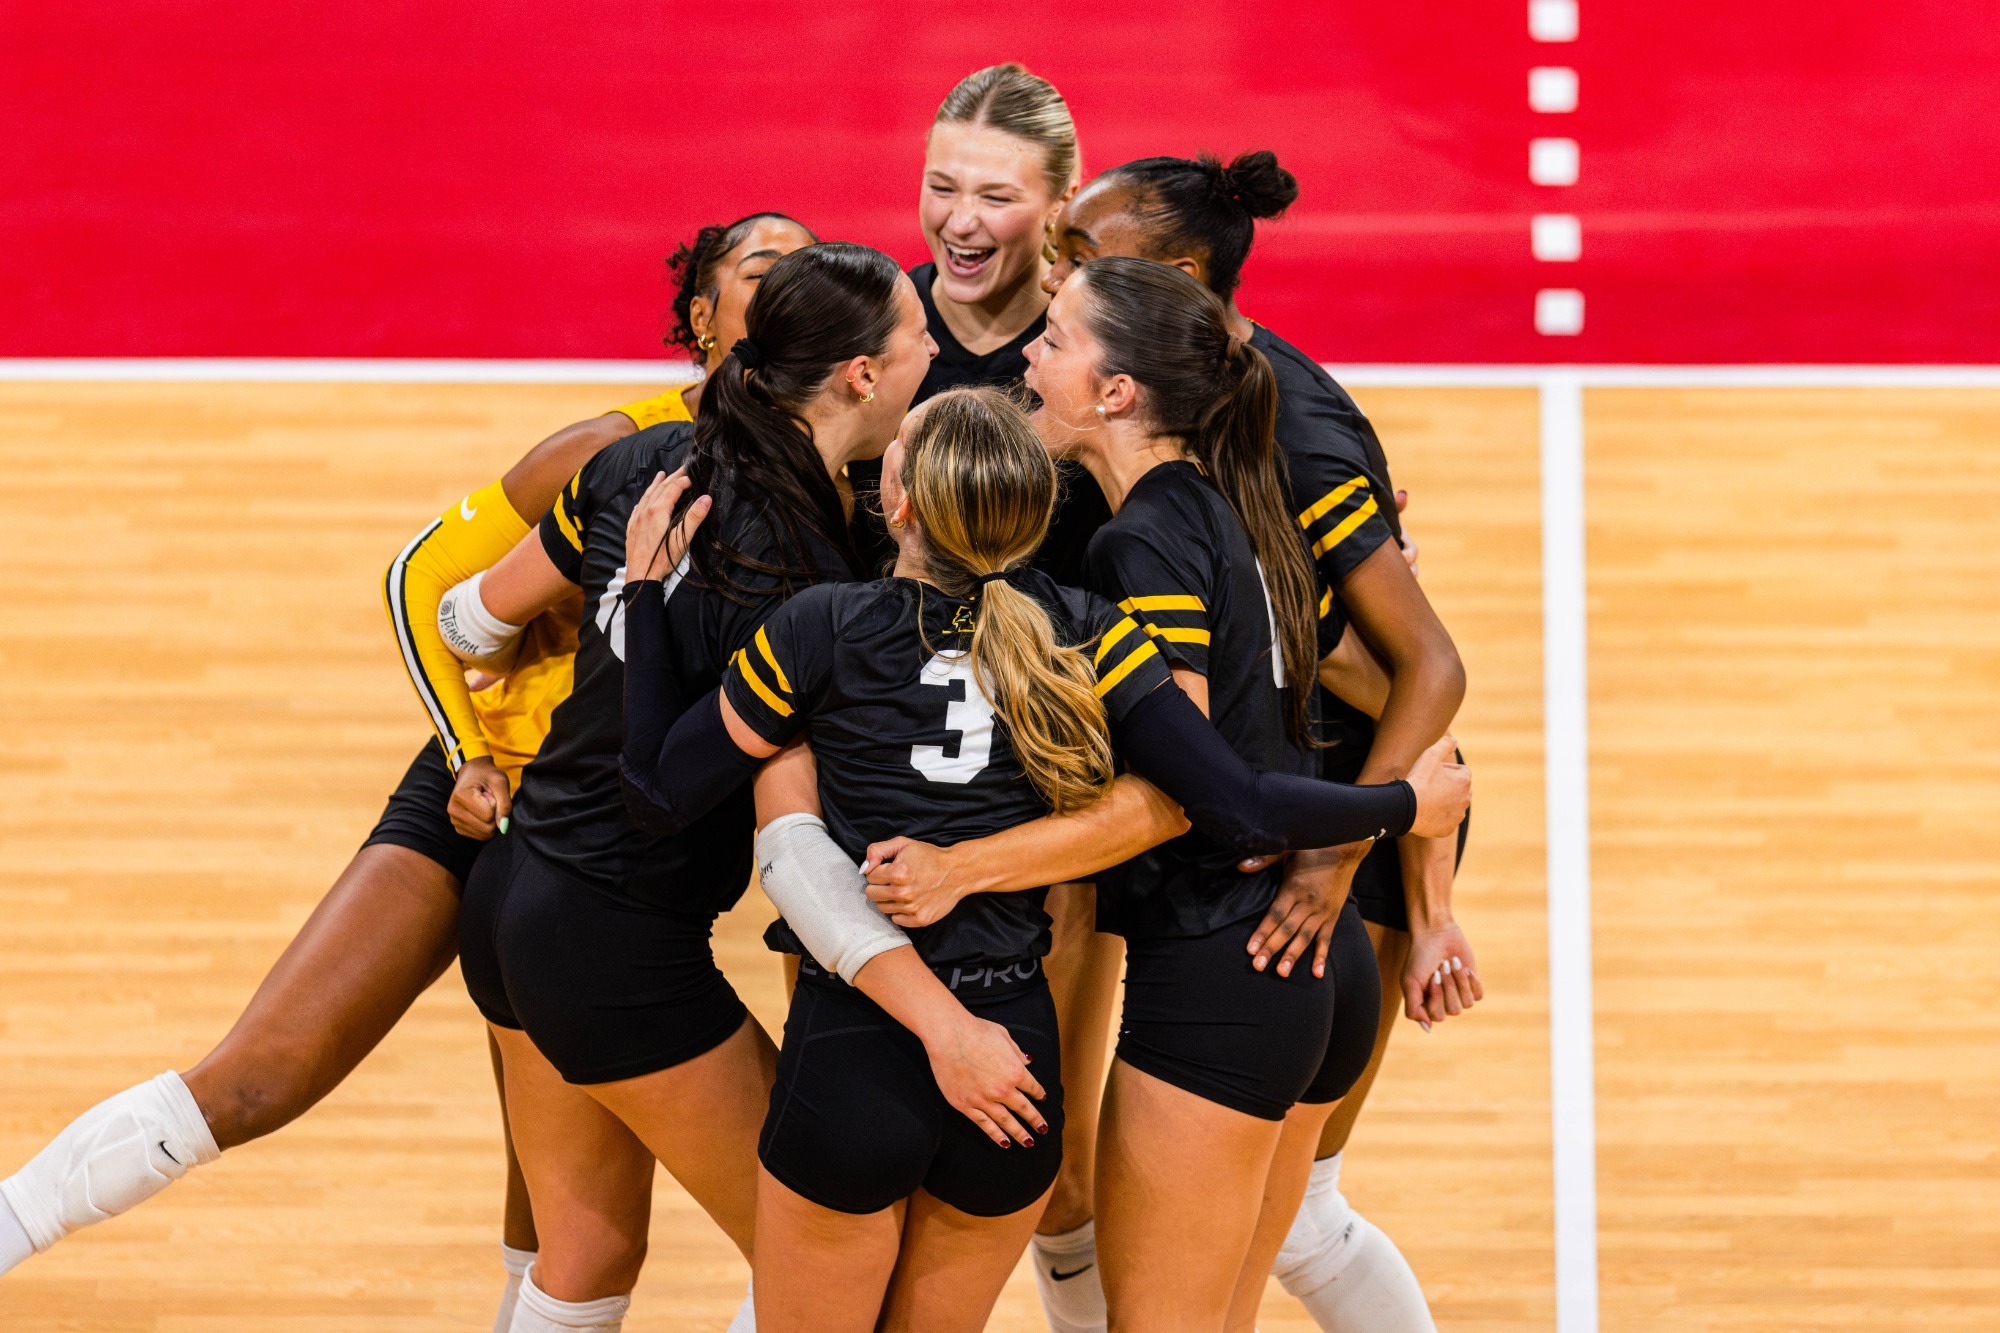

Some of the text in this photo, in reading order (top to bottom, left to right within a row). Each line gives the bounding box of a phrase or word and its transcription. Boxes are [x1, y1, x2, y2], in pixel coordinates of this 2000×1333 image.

[440, 597, 480, 655] Tandem
[910, 650, 996, 784] 3
[949, 958, 1038, 990] PRO
